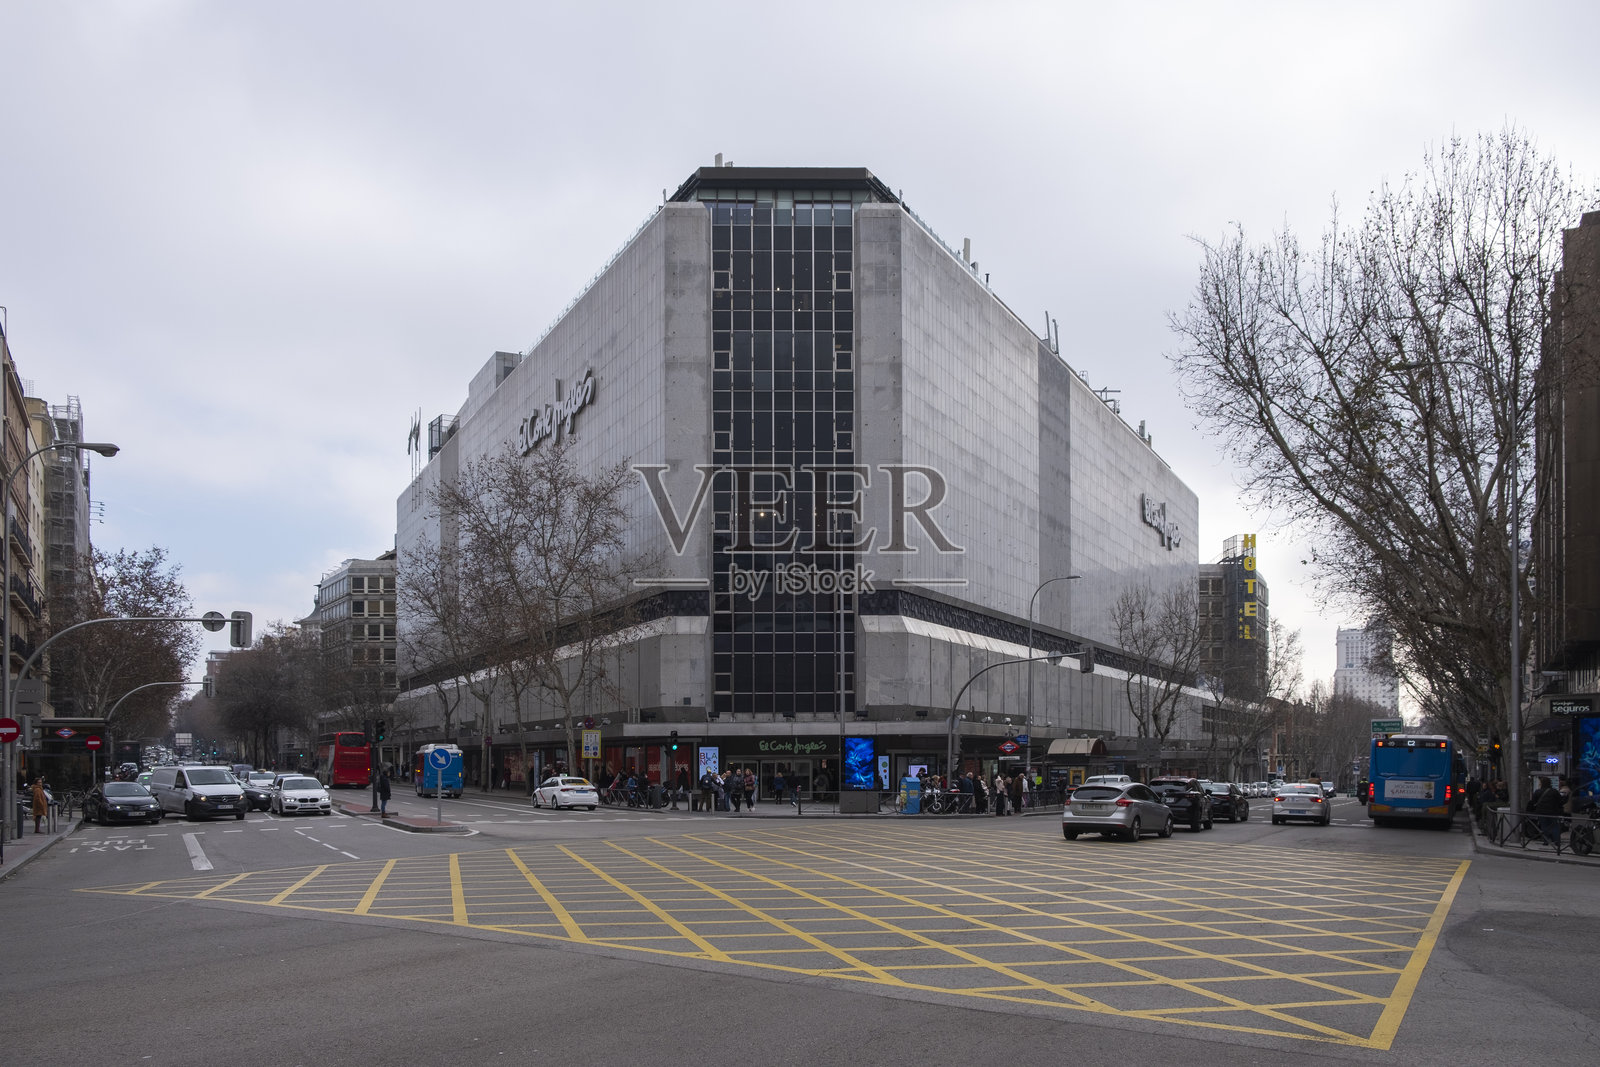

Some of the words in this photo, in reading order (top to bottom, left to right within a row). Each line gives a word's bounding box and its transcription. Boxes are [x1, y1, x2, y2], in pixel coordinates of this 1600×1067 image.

[1244, 533, 1257, 640] HOTEL
[1552, 705, 1590, 714] seguros
[759, 740, 769, 751] El
[770, 740, 793, 751] Corte
[793, 737, 827, 754] Inglés
[69, 844, 155, 853] TAXI
